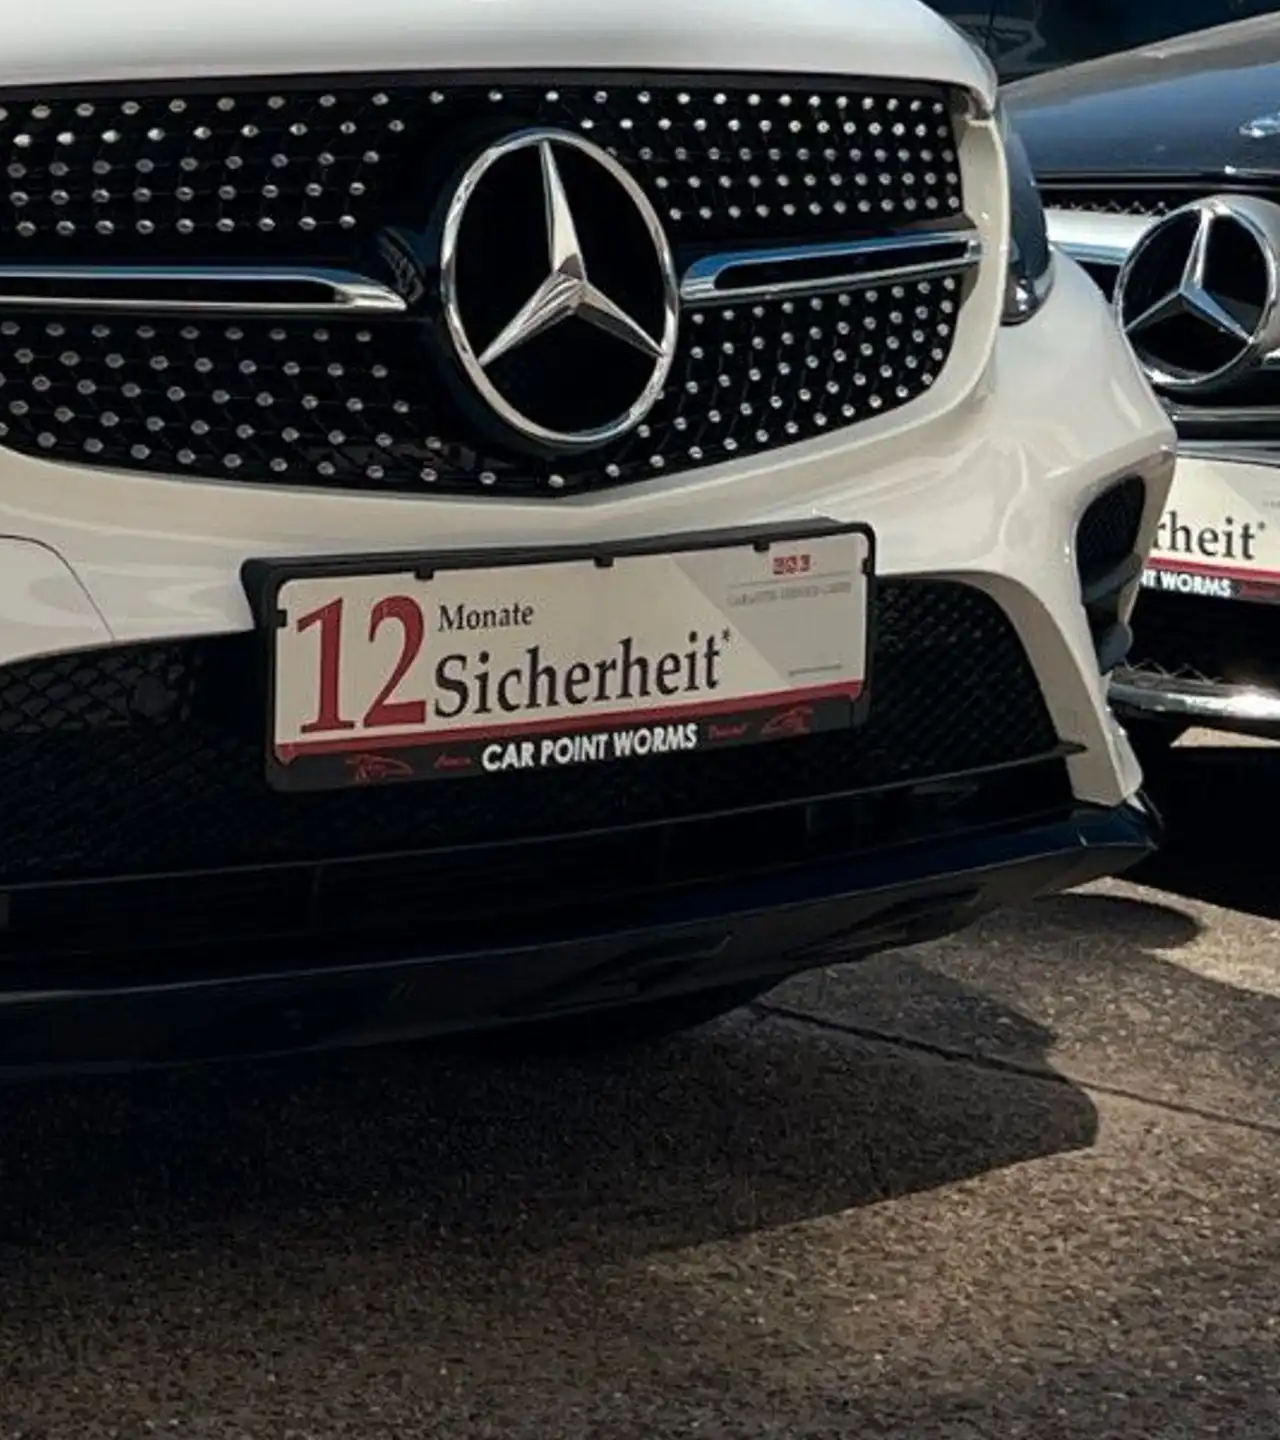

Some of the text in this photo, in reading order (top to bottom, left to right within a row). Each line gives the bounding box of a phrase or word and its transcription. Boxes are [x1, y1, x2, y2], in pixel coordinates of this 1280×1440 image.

[1160, 569, 1231, 597] WORMS
[438, 602, 534, 632] Monate
[296, 594, 428, 733] 12
[481, 741, 535, 772] CAR
[540, 732, 609, 766] POINT
[612, 722, 698, 757] WORMS
